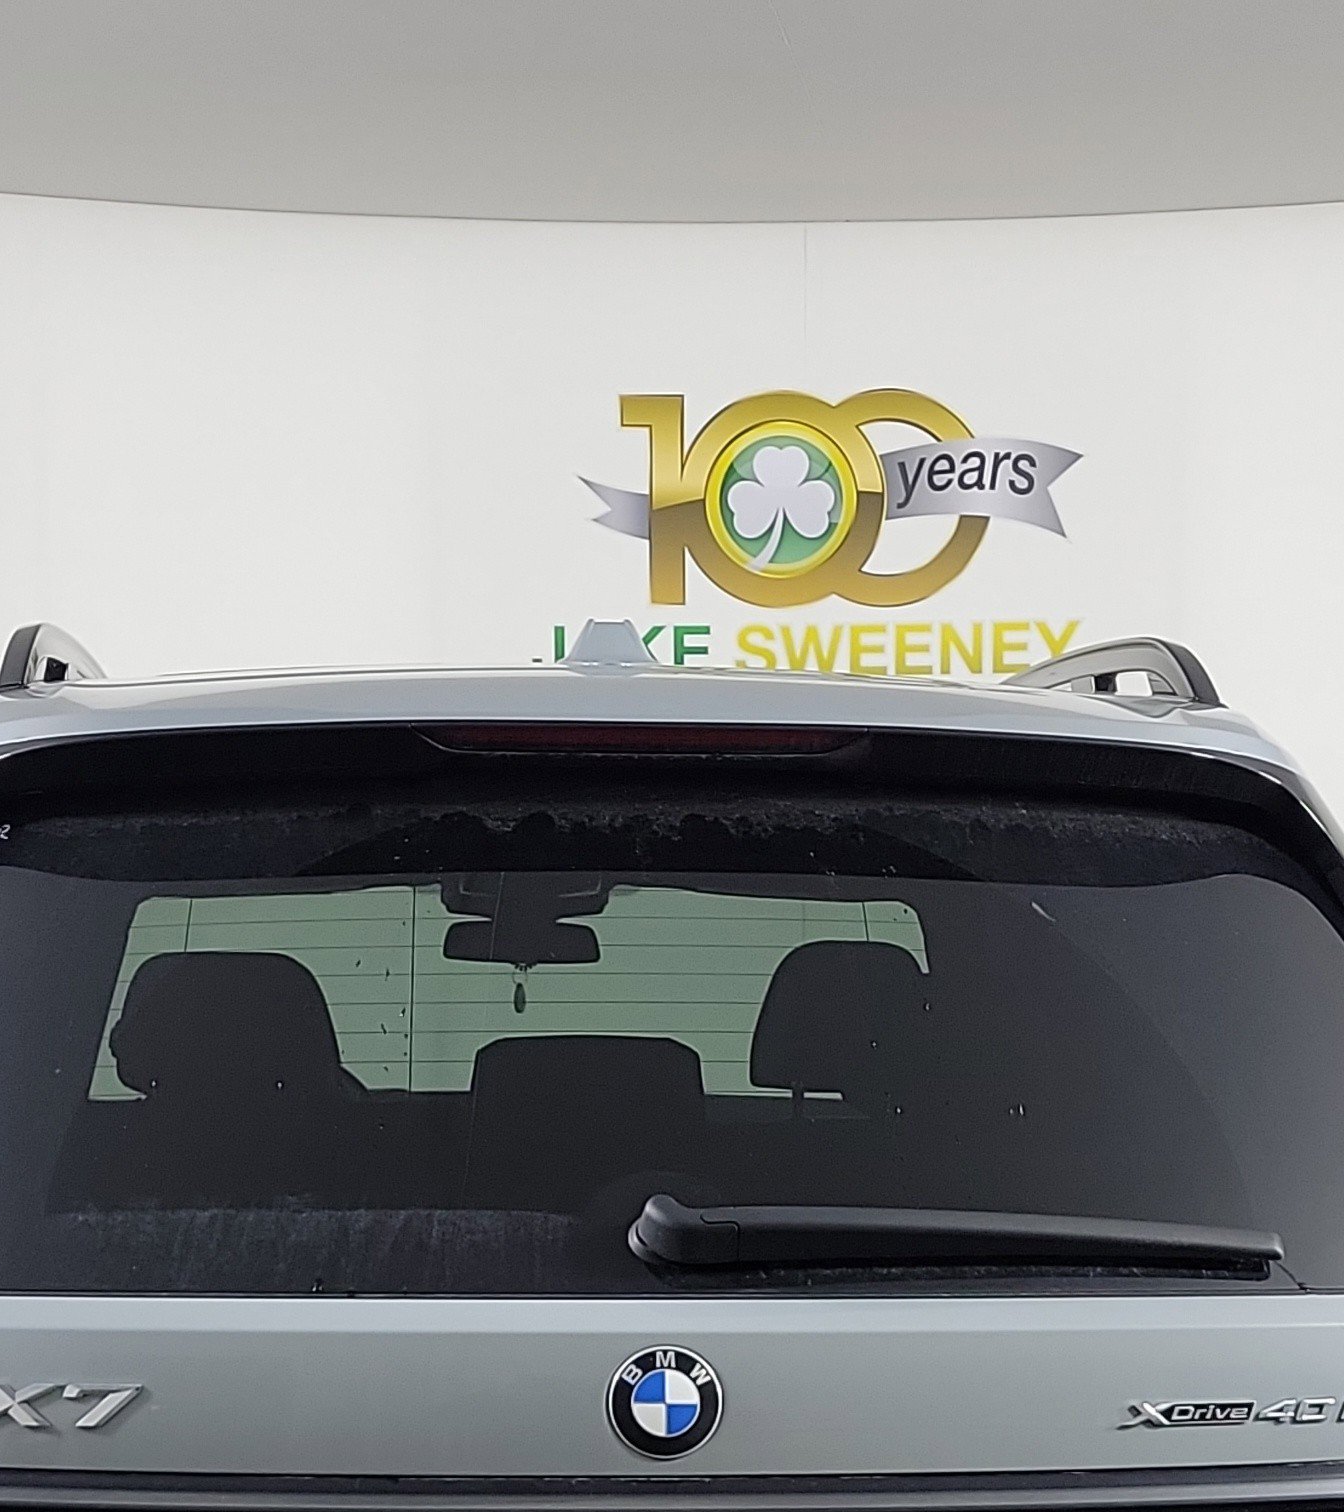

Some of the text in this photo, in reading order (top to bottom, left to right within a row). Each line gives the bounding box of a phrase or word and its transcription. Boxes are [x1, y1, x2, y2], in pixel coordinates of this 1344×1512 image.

[619, 388, 1038, 607] 100 years
[736, 621, 1080, 675] SWEENEY
[621, 1350, 712, 1386] BMW
